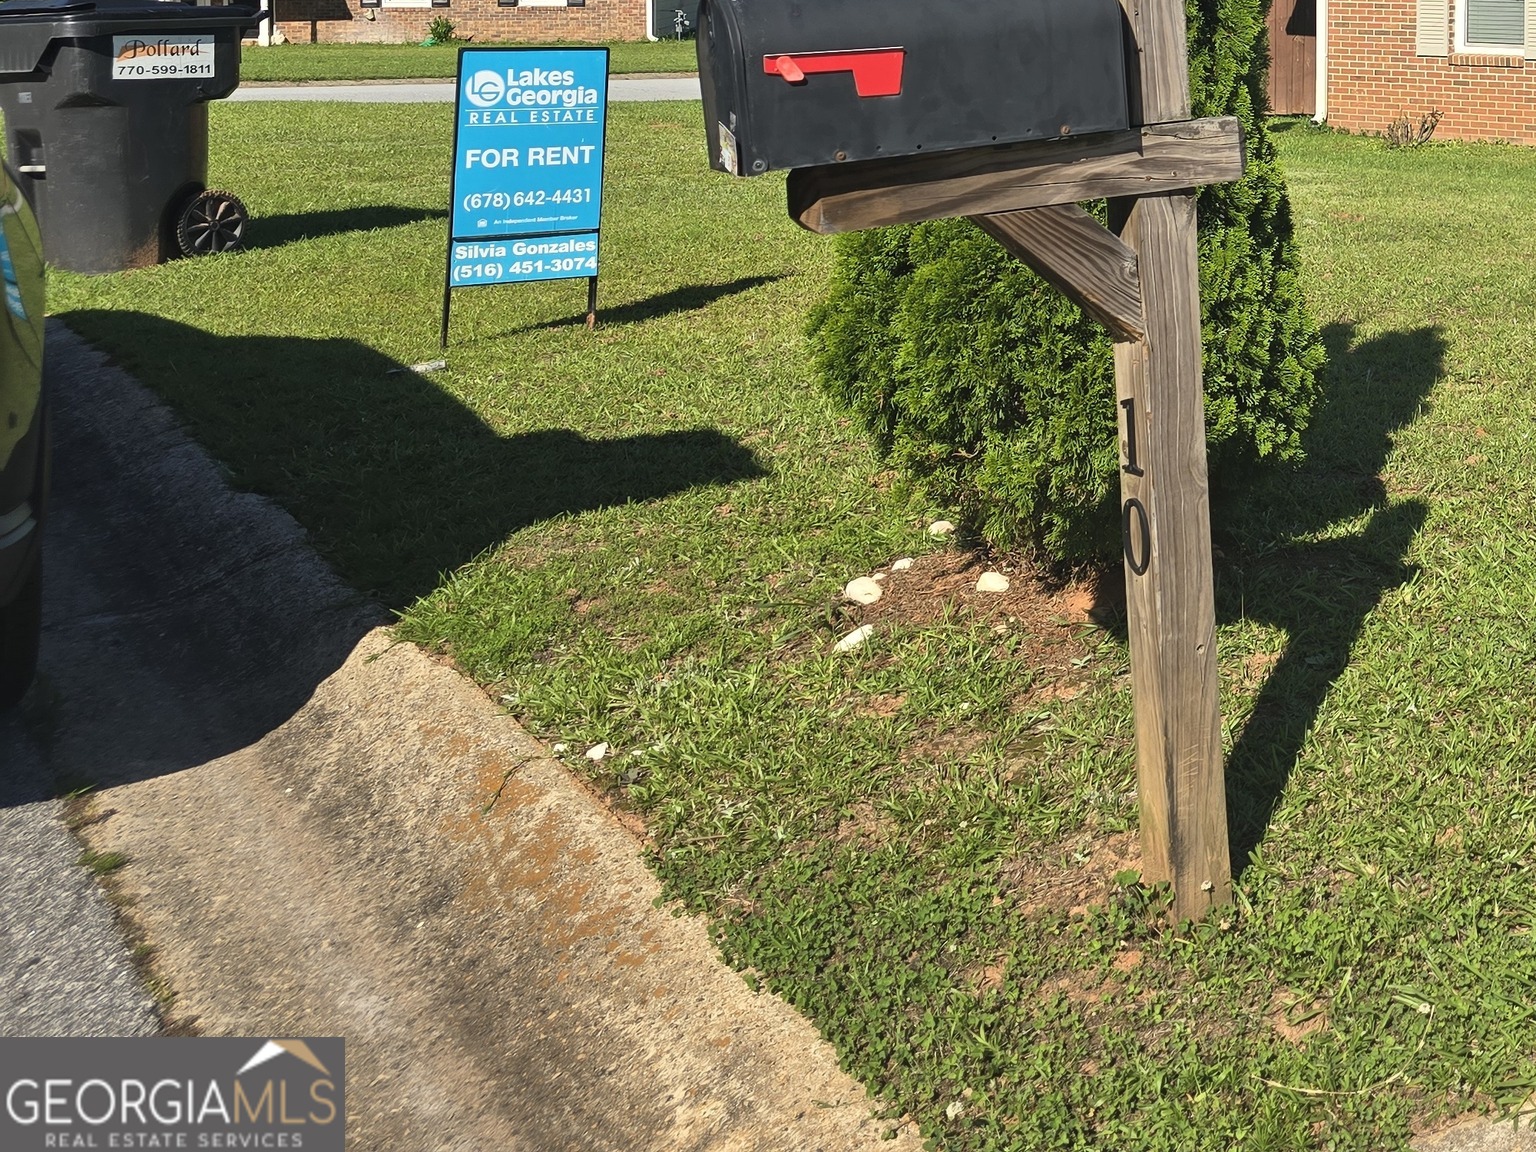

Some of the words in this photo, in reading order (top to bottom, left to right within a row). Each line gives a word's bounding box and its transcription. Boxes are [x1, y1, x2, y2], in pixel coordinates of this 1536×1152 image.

[124, 39, 202, 59] Pollard
[117, 64, 211, 75] 770-599-1811
[507, 68, 574, 86] Lakes
[506, 86, 597, 108] Georgia
[469, 110, 518, 124] REAL
[530, 109, 595, 123] ESTATE
[465, 148, 519, 169] FOR
[528, 145, 595, 166] RENT
[463, 192, 511, 213] (678)
[513, 188, 591, 206] 642-4431
[455, 244, 507, 260] Silvia
[512, 240, 596, 256] Gonzales
[453, 263, 503, 281] (516)
[509, 256, 597, 274] 451-3074
